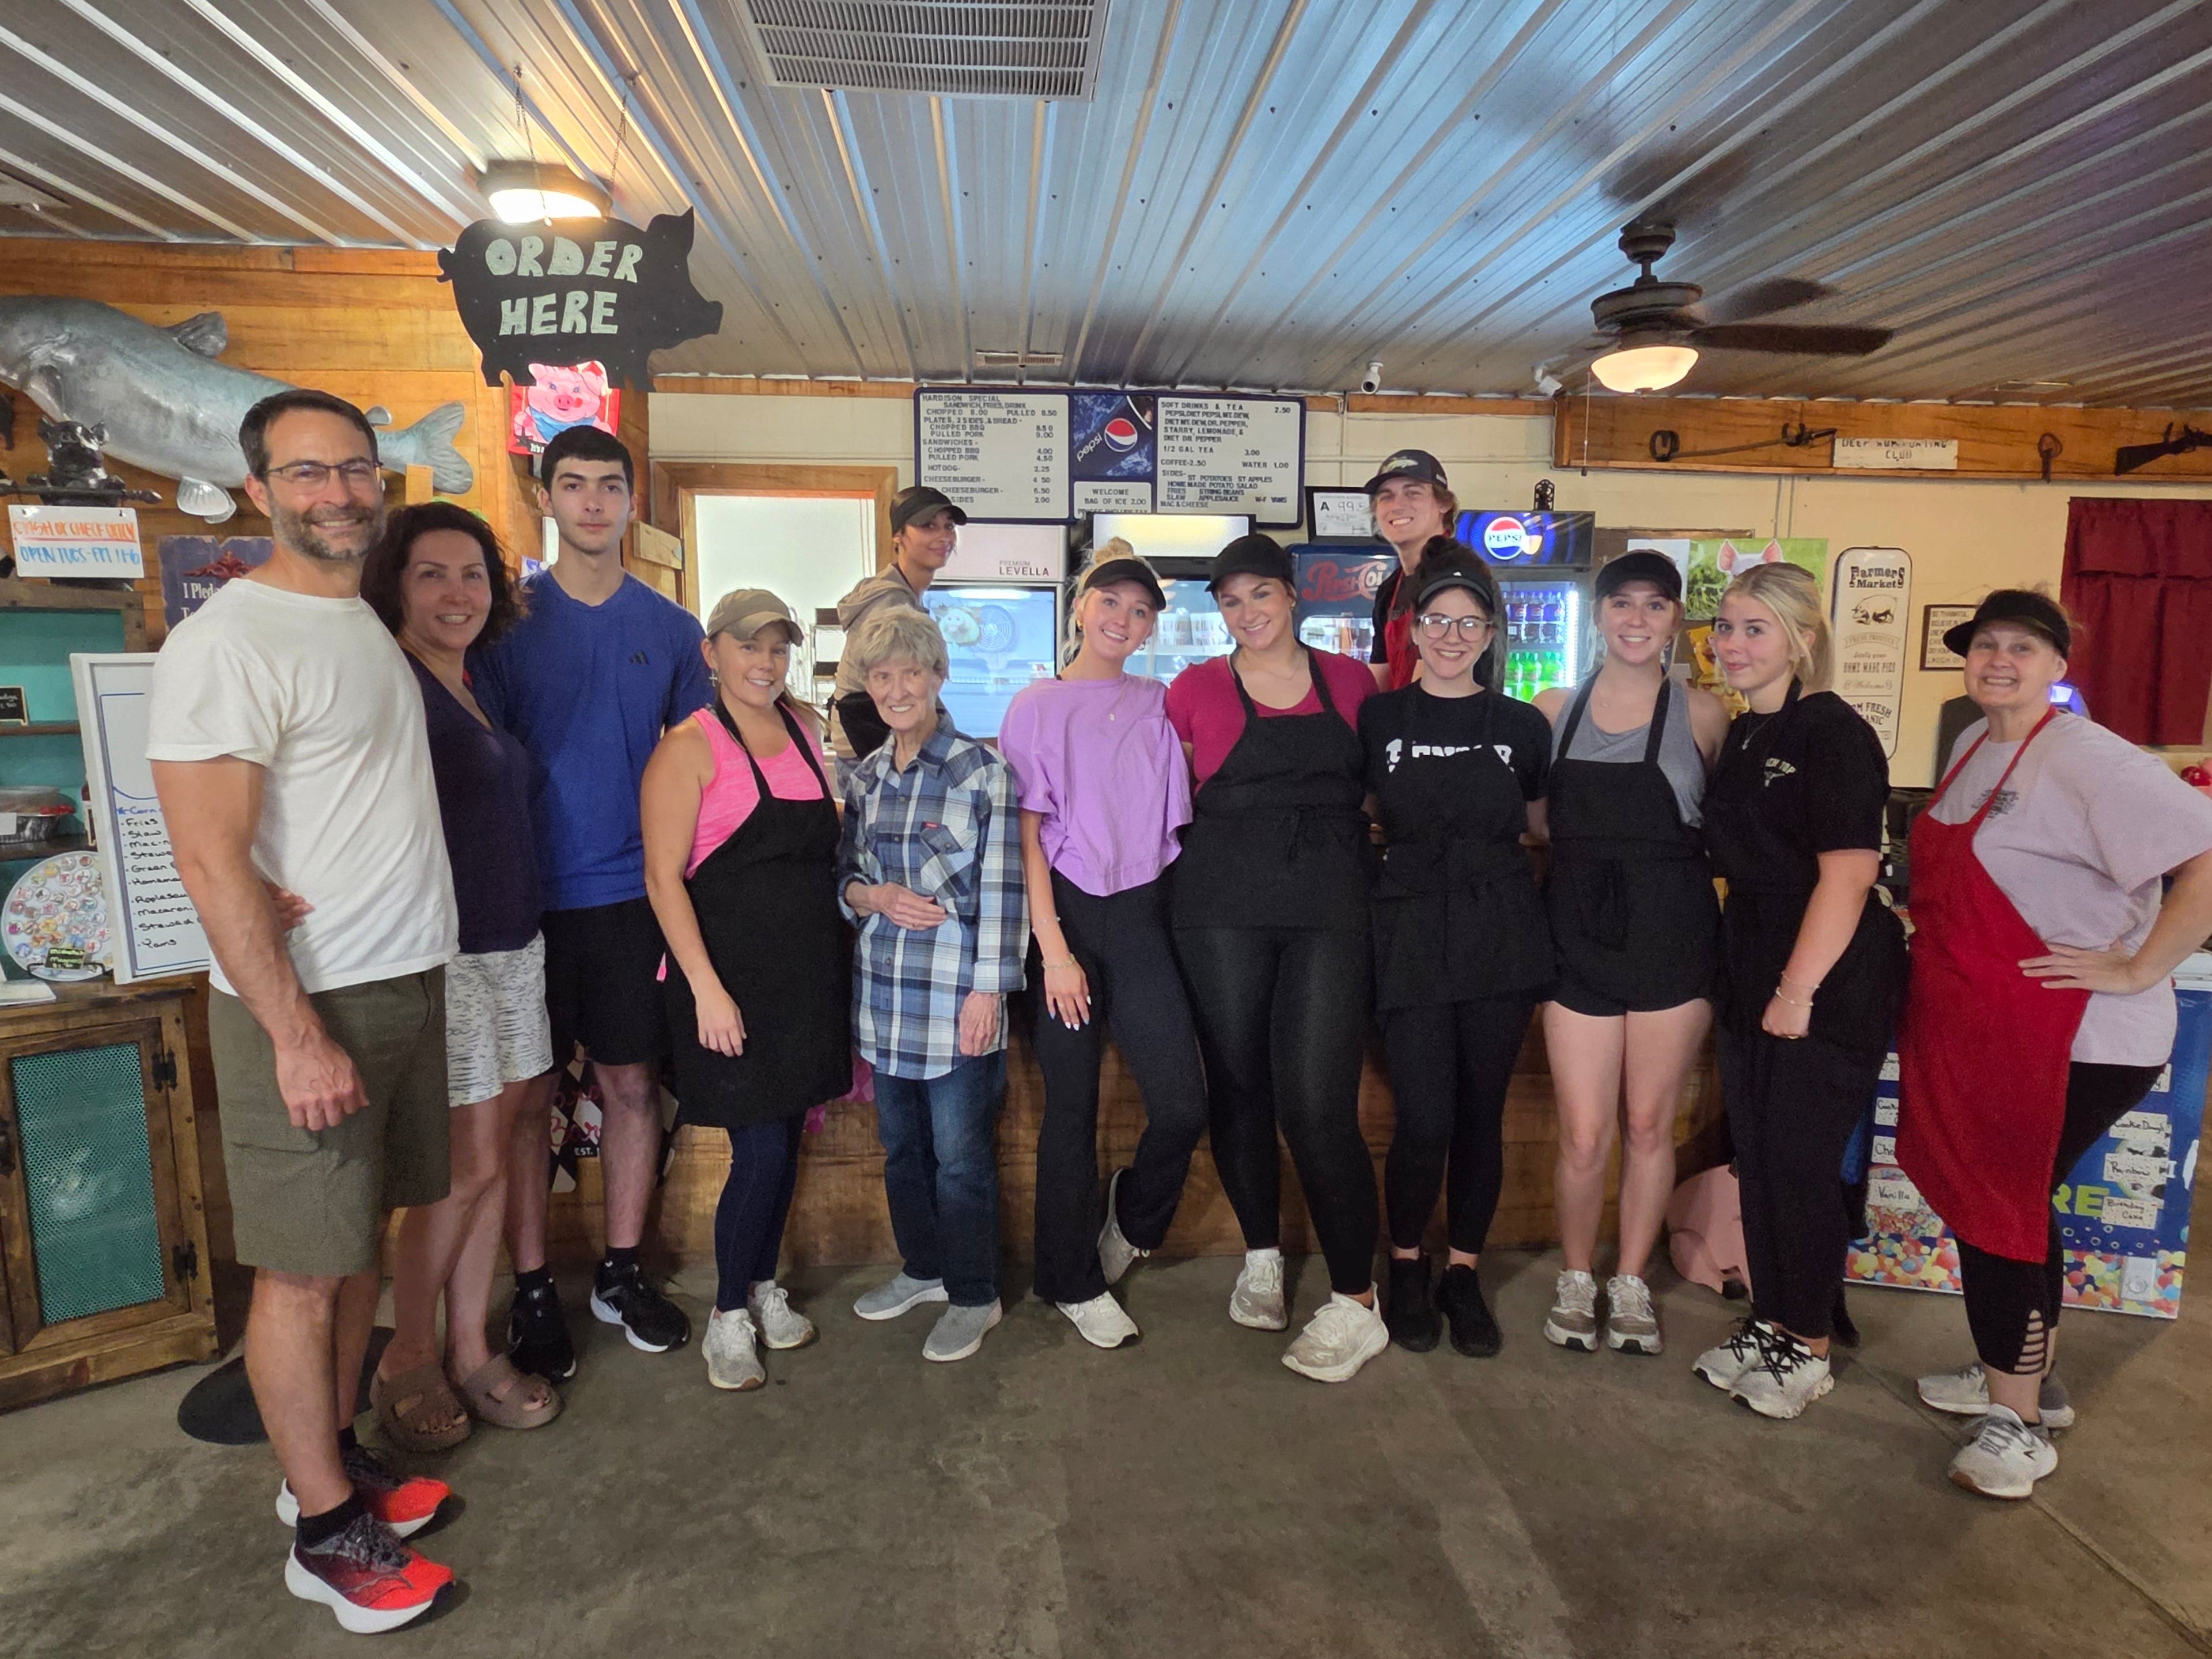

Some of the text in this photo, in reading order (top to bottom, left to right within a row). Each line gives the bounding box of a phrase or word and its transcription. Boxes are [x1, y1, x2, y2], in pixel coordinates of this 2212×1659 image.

[485, 236, 643, 283] ORDER
[499, 291, 619, 336] HERE
[1077, 433, 1103, 462] pepsi
[1320, 502, 1330, 511] A
[20, 546, 56, 563] OPEN
[999, 567, 1049, 575] LEVELLA
[1850, 566, 1905, 588] Farmers
[1857, 579, 1896, 588] Market
[183, 582, 189, 599] I
[1865, 702, 1893, 718] FRESH
[130, 806, 157, 815] Corn
[126, 818, 158, 827] Fries
[128, 830, 162, 839] Slaw
[130, 851, 172, 859] Stewe
[131, 865, 168, 873] Green
[138, 907, 194, 916] Macaroni
[138, 919, 195, 931] Stewed
[141, 938, 177, 949] Yams
[574, 1147, 593, 1156] EST.
[2111, 1161, 2150, 1177] Rainbow
[1878, 1185, 1910, 1200] Vanilla
